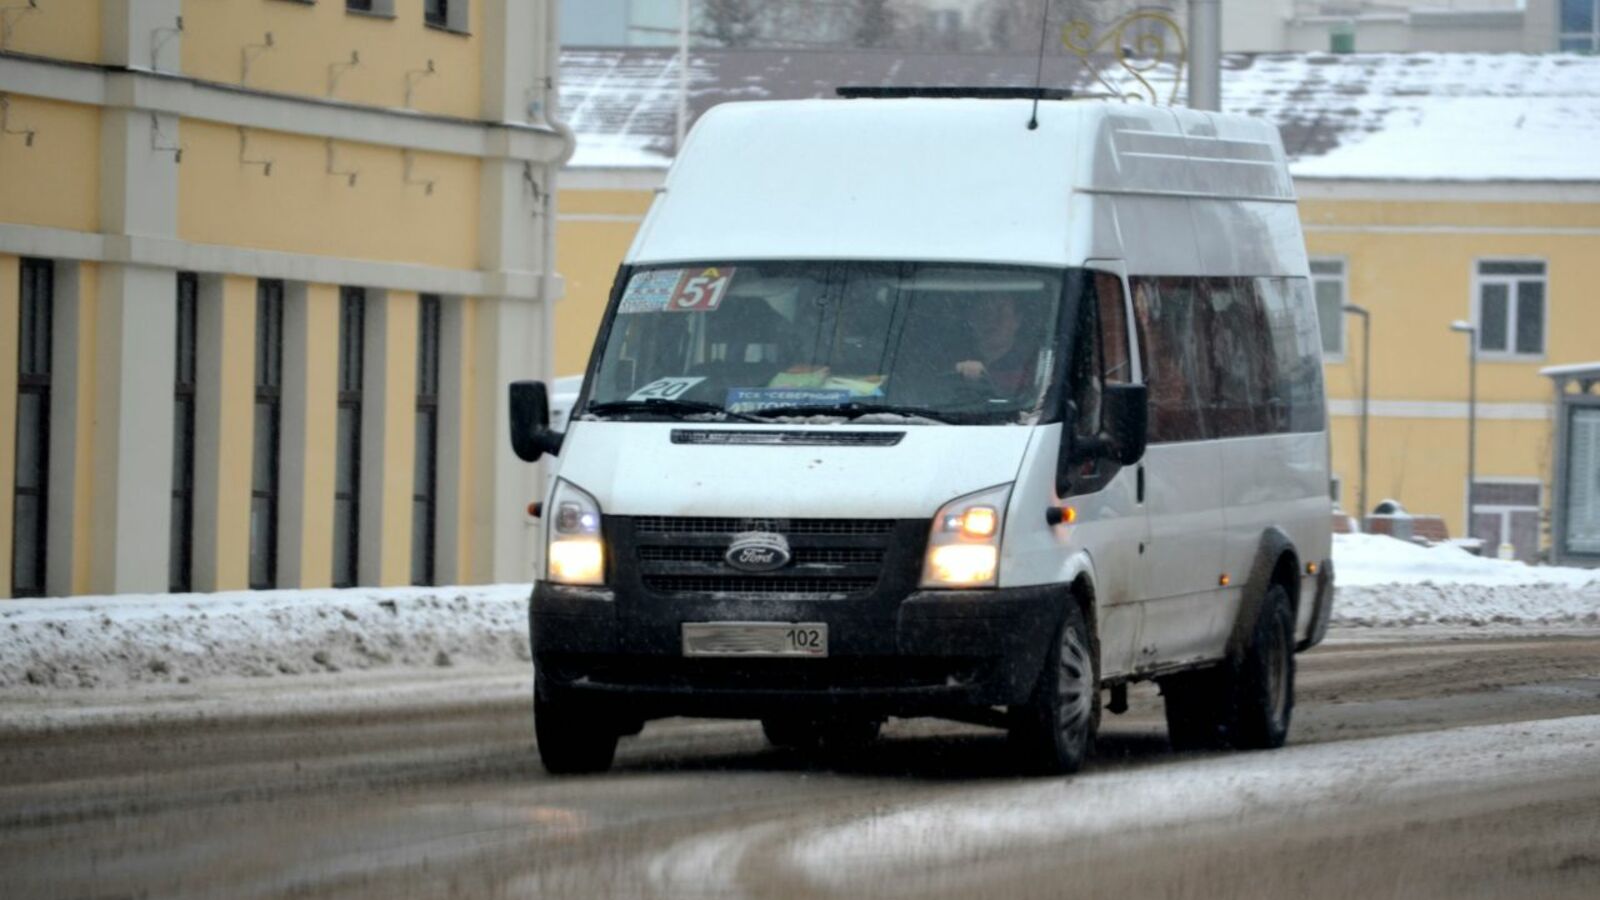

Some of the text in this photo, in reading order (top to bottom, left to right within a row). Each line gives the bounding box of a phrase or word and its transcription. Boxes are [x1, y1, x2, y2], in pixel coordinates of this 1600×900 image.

[677, 276, 728, 308] 51
[637, 381, 689, 397] 20
[739, 548, 775, 563] Ford
[786, 629, 820, 648] 102
